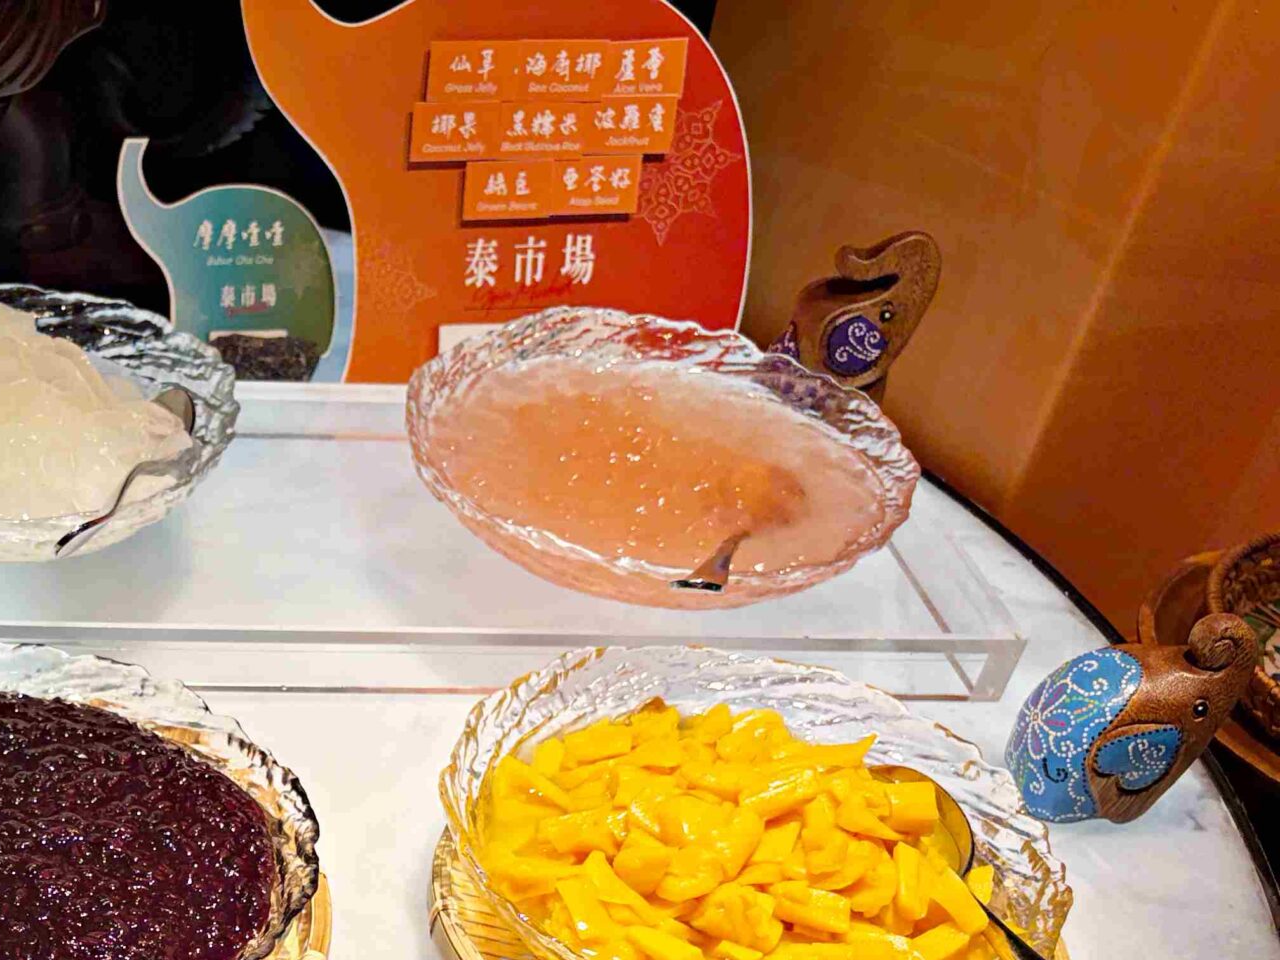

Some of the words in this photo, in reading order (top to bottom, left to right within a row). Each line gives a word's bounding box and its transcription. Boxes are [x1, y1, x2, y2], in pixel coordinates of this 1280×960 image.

[449, 49, 495, 81] 仙草
[548, 82, 589, 92] Coconut
[431, 111, 477, 139] 椰果
[605, 135, 650, 146] Jackfruit
[464, 233, 596, 288] 泰市場
